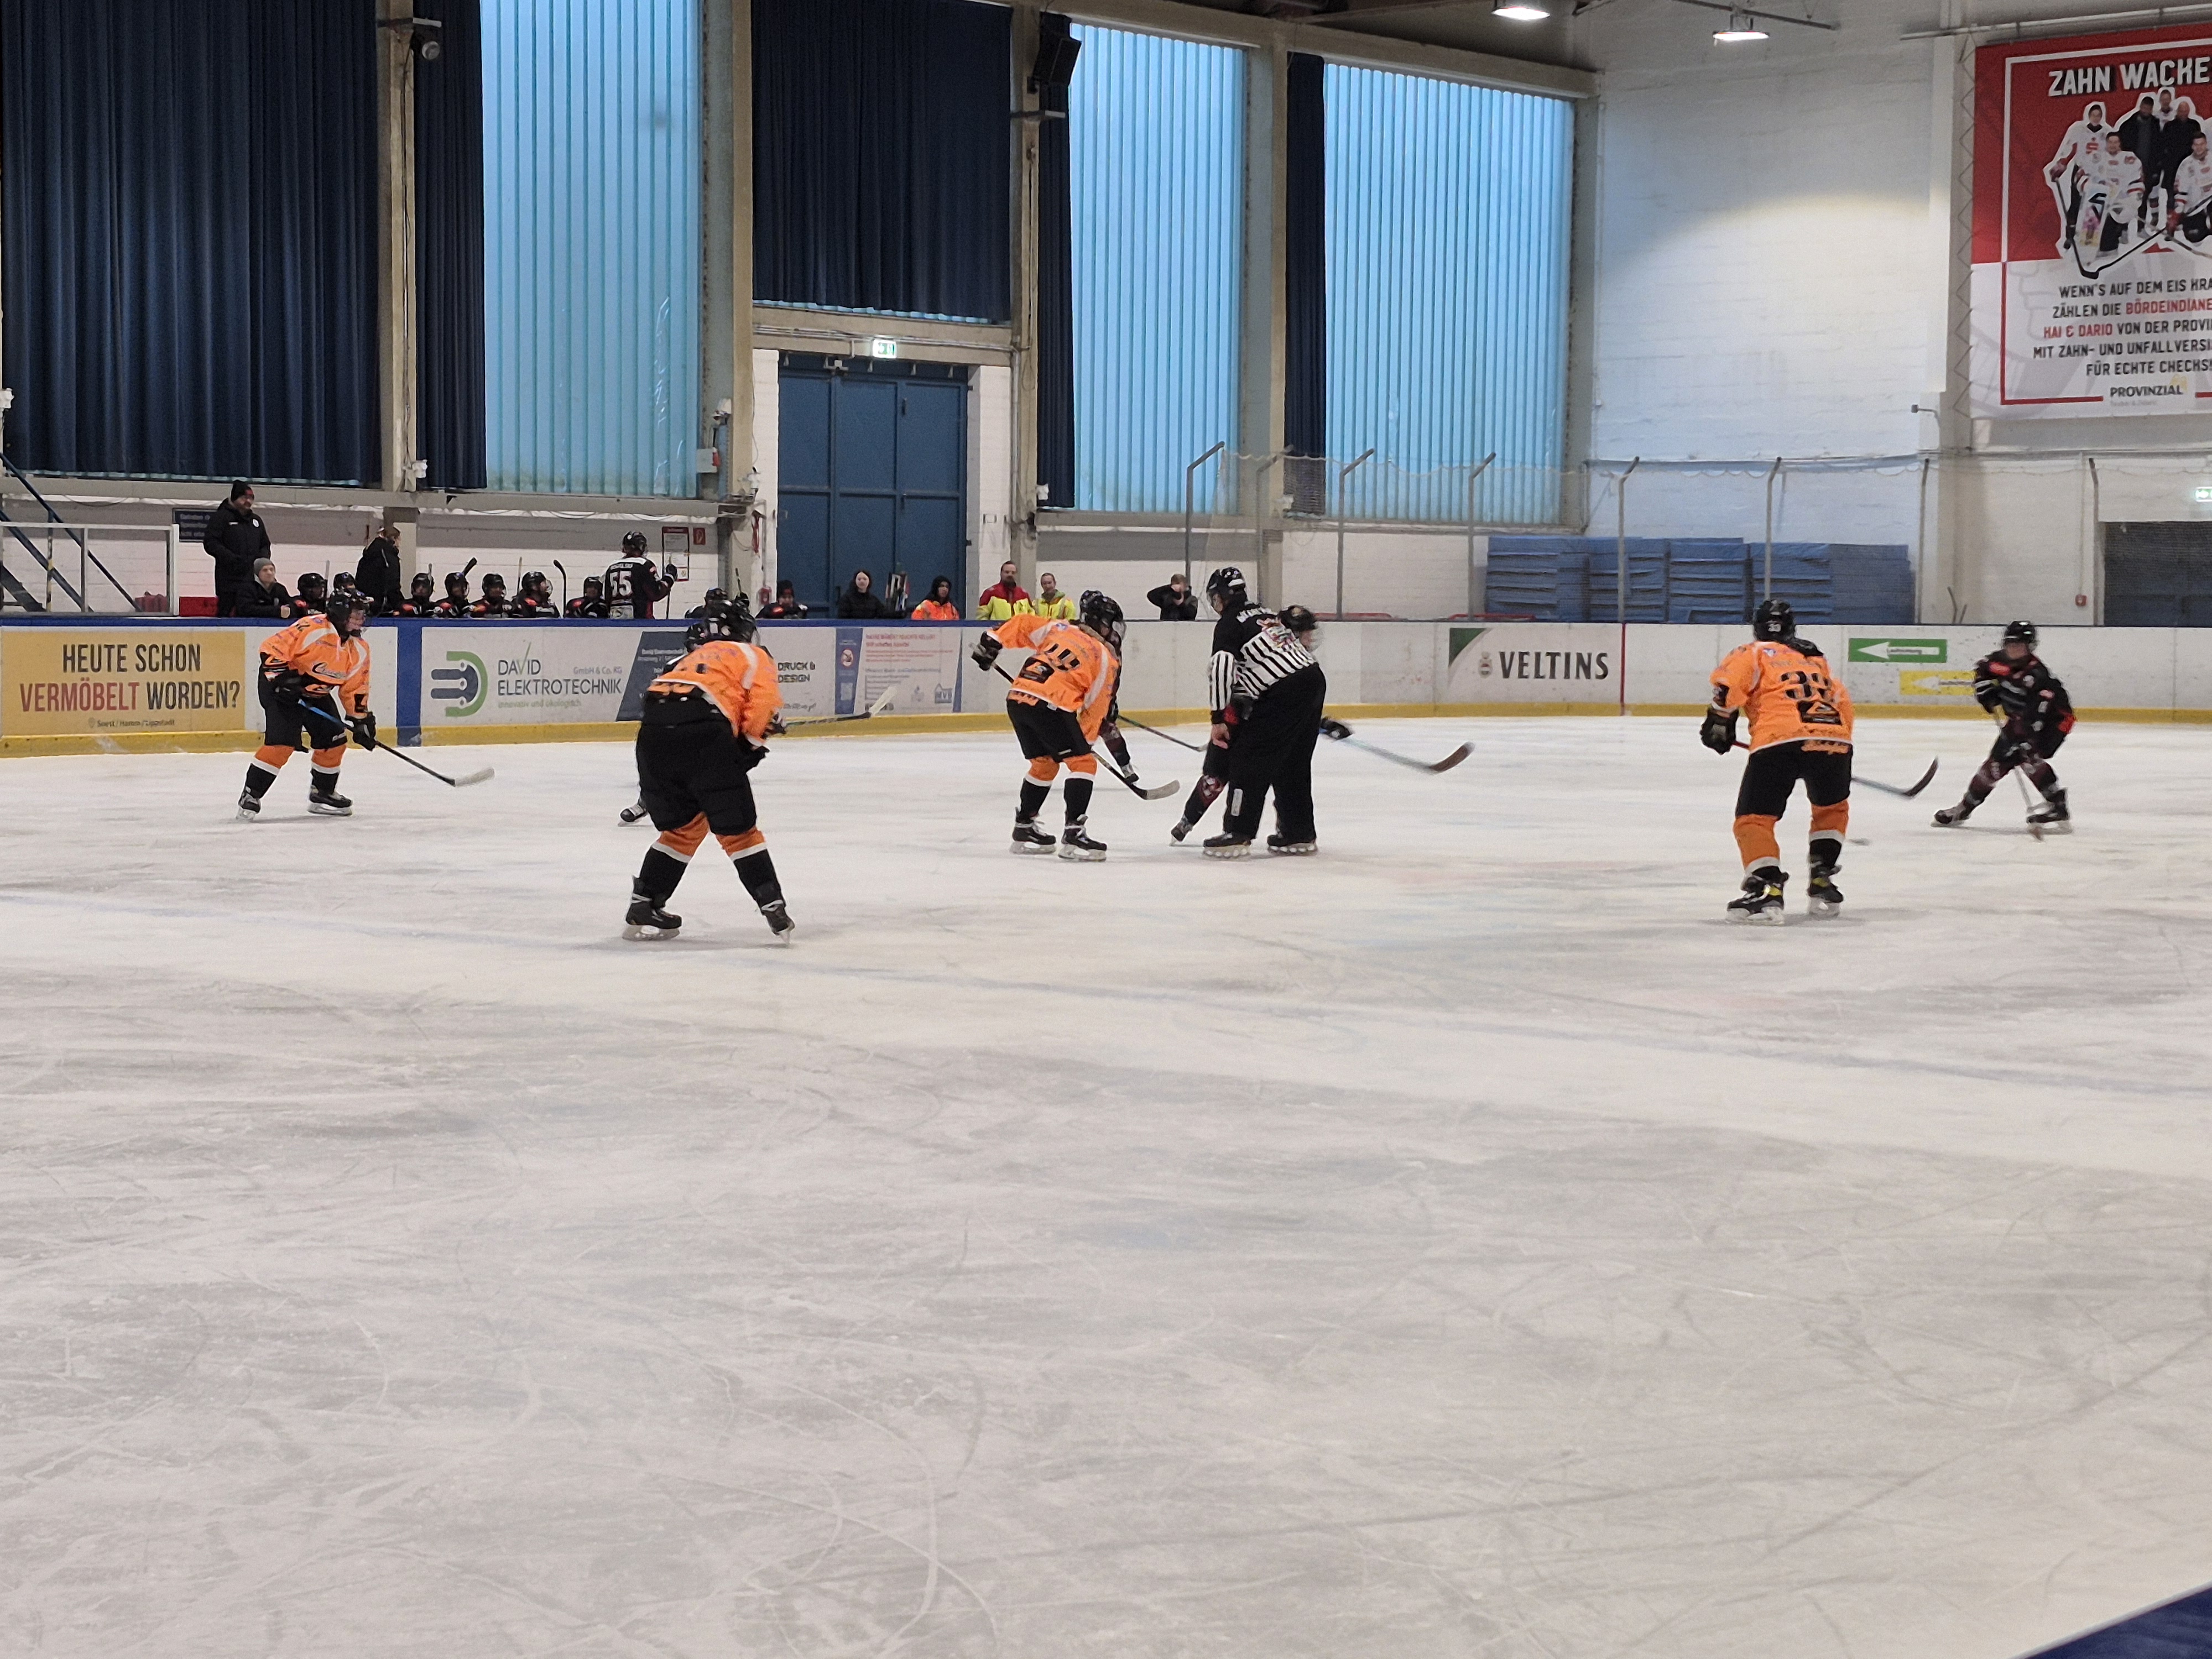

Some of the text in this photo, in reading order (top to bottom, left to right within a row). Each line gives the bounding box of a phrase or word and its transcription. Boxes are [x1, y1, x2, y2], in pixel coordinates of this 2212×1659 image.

[2048, 56, 2211, 97] ZAHN WACKE
[2059, 284, 2106, 298] WENN'S
[2110, 282, 2132, 295] AUF
[2137, 280, 2163, 294] DEM
[2167, 279, 2186, 293] EIS
[2052, 302, 2098, 319] ZÄHLEN
[2103, 303, 2121, 316] DIE
[2078, 323, 2113, 337] DARIO
[2117, 322, 2141, 335] VON
[2145, 320, 2169, 334] DER
[2033, 346, 2054, 359] MIT
[2058, 343, 2095, 358] ZAHN-
[2099, 342, 2123, 356] UND
[2086, 360, 2110, 376] FÜR
[2114, 361, 2154, 375] ECHTE
[2110, 384, 2184, 397] PROVINZIAL
[609, 571, 632, 597] 55
[62, 643, 201, 673] HEUTE SCHON
[778, 662, 808, 671] DRUCK
[1499, 651, 1609, 680] VELTINS
[19, 676, 241, 712] VERMÖBELT WORDEN?
[498, 678, 622, 696] ELEKTROTECHNIK
